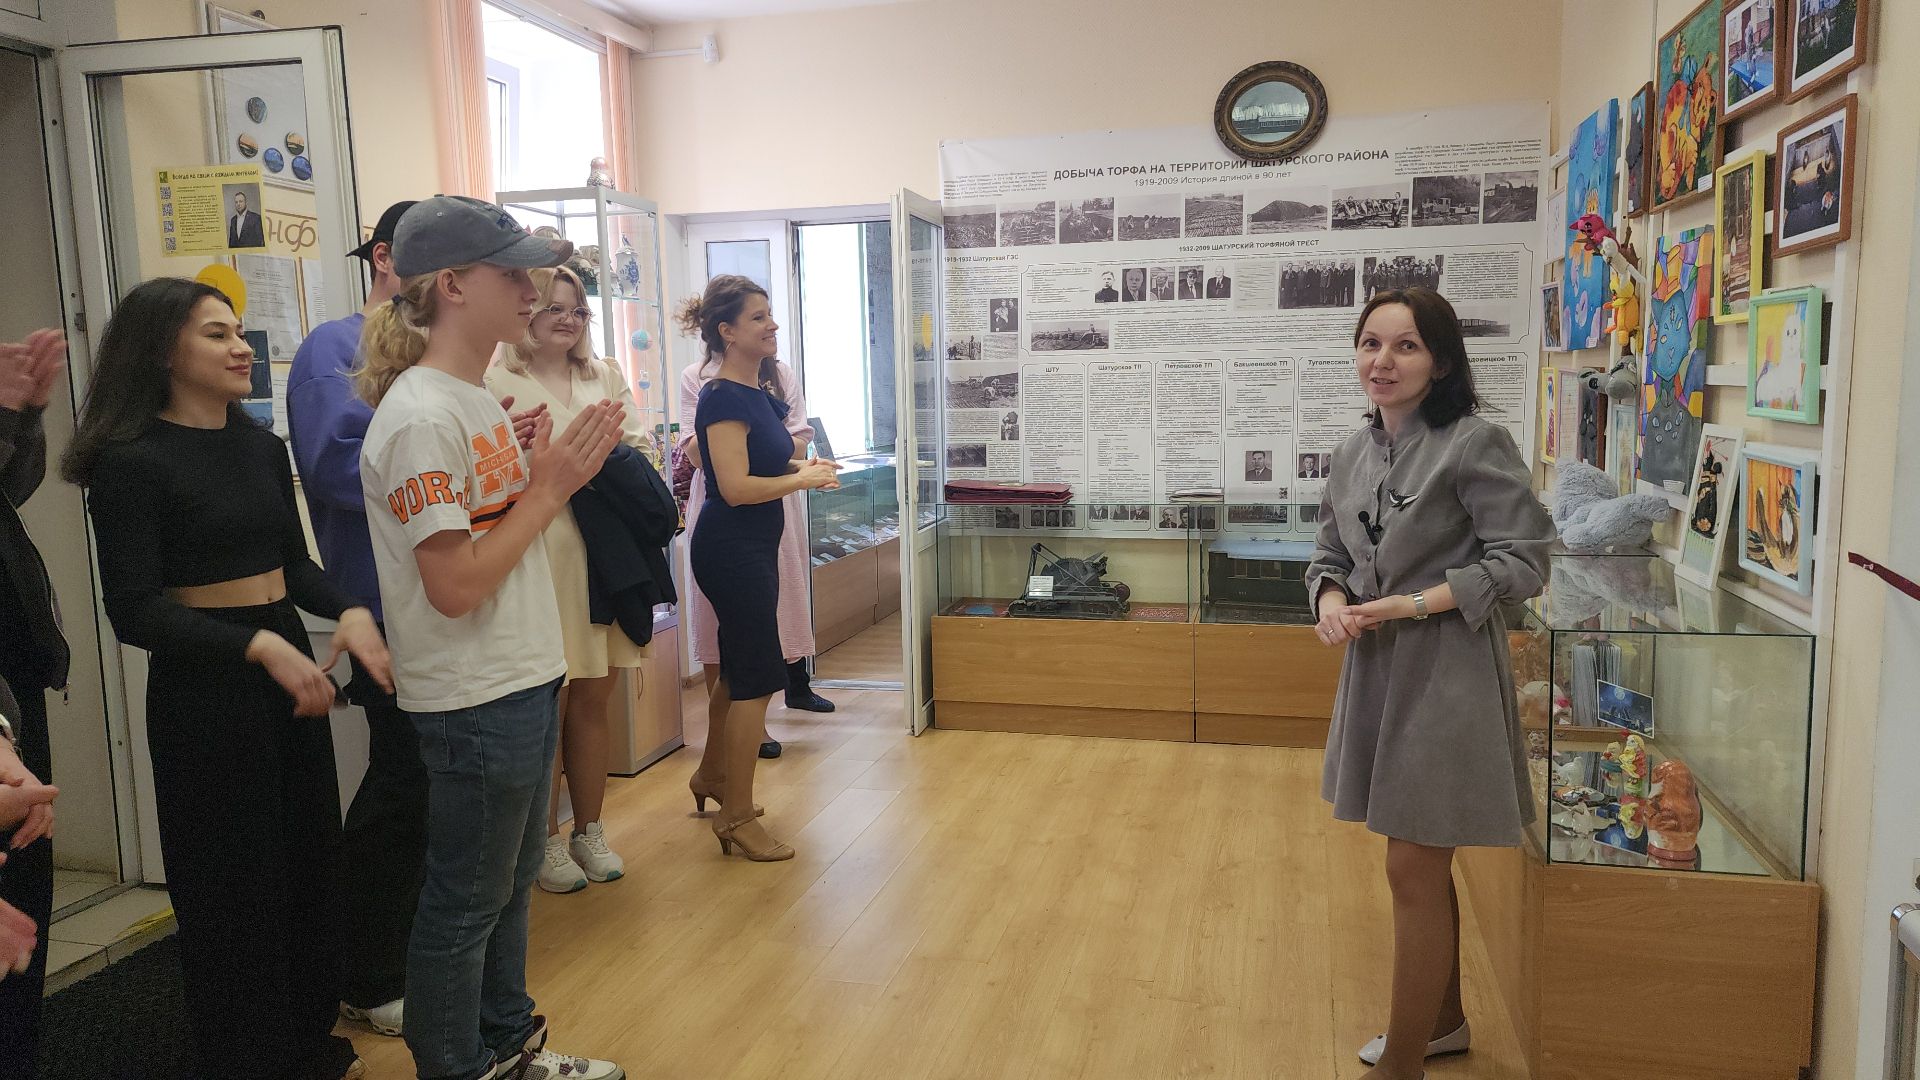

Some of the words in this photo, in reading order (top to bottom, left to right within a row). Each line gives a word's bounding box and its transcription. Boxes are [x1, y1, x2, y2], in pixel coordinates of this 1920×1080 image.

[1053, 167, 1104, 181] ДОБЫЧА
[1107, 165, 1147, 176] ТОРФА
[1150, 164, 1166, 174] НА
[1169, 160, 1247, 173] ТЕРРИТОРИИ
[1337, 149, 1389, 162] РАЙОНА
[1134, 177, 1178, 187] 1919-2009
[1180, 175, 1217, 186] История
[1219, 172, 1253, 183] длиной
[1262, 171, 1273, 179] 90
[1276, 170, 1292, 178] лет
[1211, 242, 1254, 251] ШАТУРСКИЙ
[1255, 239, 1295, 249] ТОРФЯНОЙ
[1296, 239, 1320, 247] ТРЕСТ
